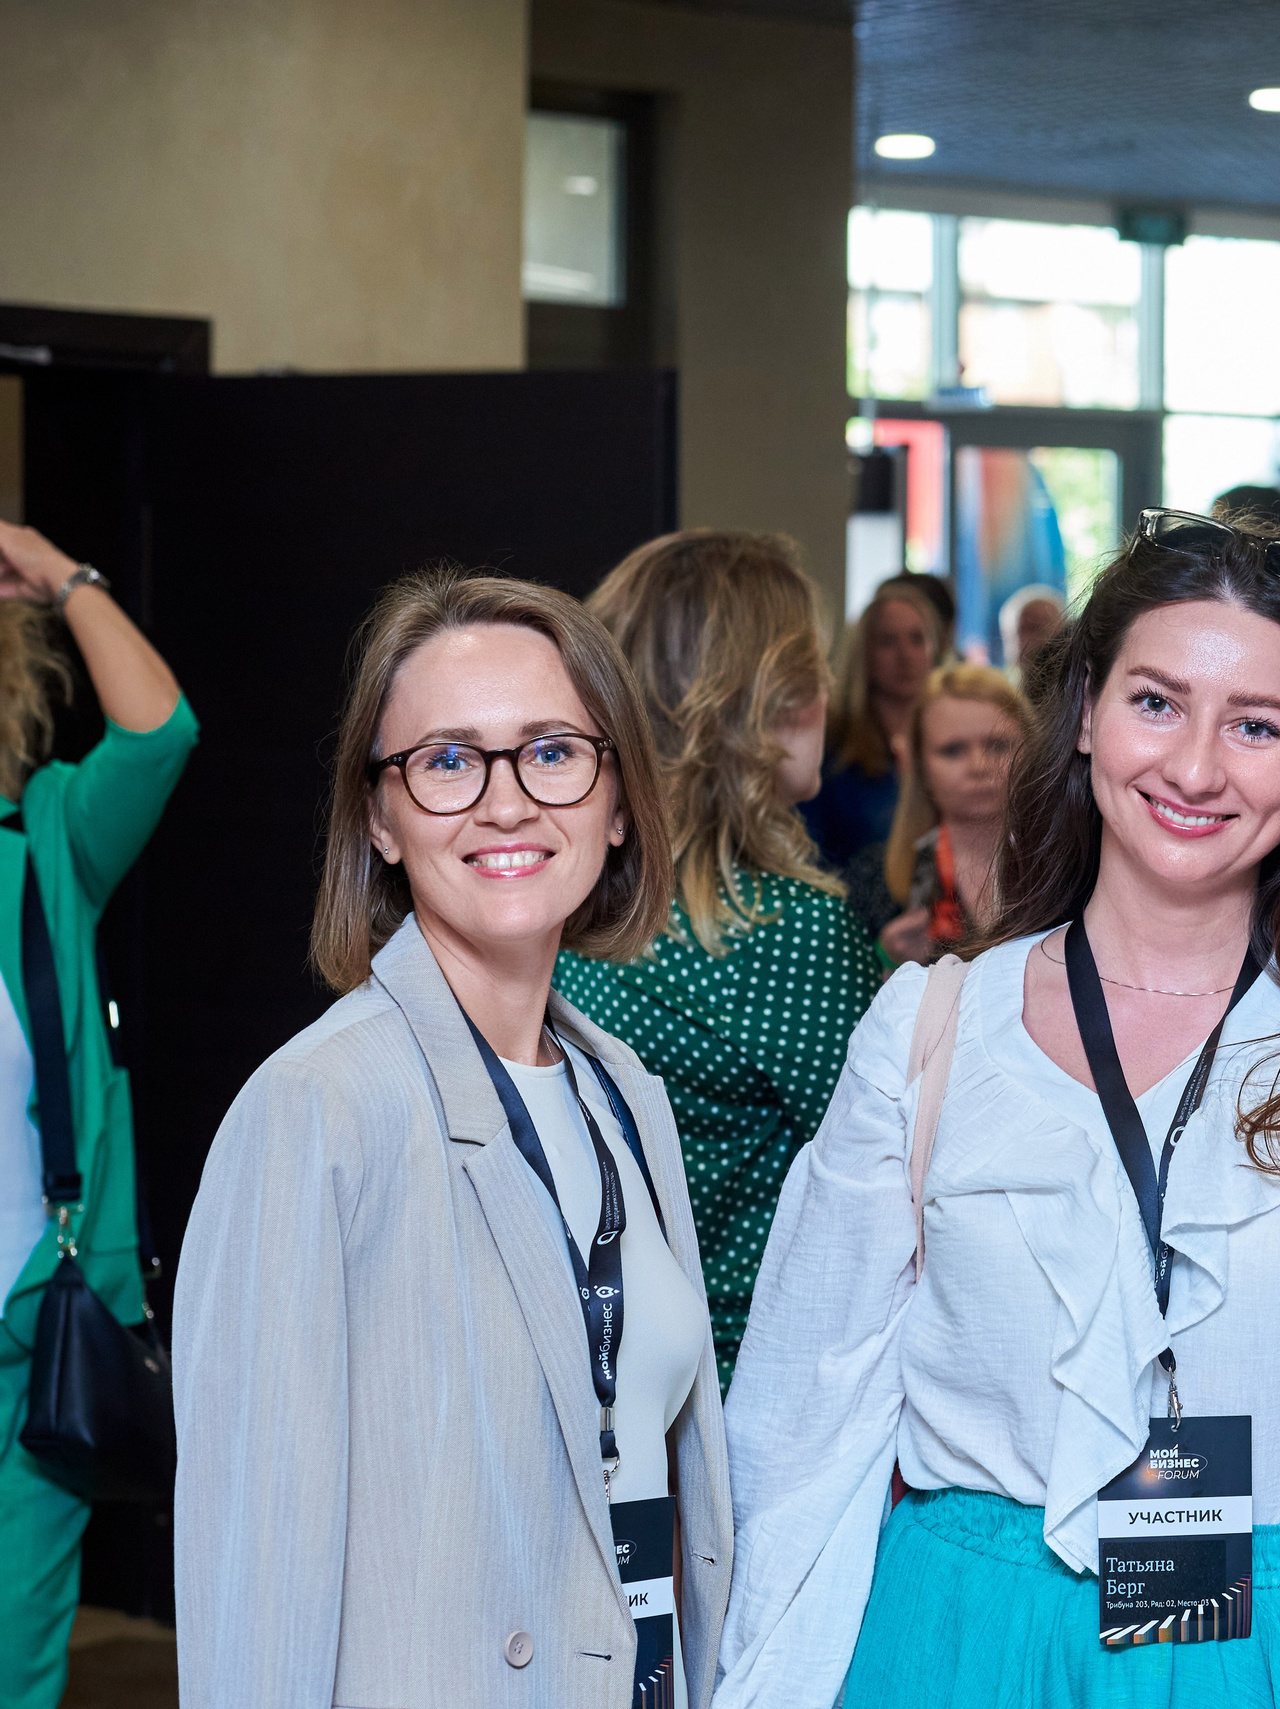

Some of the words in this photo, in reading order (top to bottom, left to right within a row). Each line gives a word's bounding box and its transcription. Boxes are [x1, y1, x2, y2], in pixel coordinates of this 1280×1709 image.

[598, 1303, 612, 1380] мойбизнес
[1149, 1443, 1179, 1458] МОЙ
[1150, 1458, 1199, 1469] БИЗНЕС
[1157, 1469, 1200, 1480] FORUM
[1128, 1508, 1223, 1525] УЧАСТНИК
[1106, 1557, 1175, 1573] Татьяна
[1106, 1579, 1145, 1598] Берг
[1106, 1600, 1134, 1610] Трибуна
[1150, 1600, 1165, 1608] Ряд:
[1165, 1600, 1177, 1608] 02,
[1177, 1599, 1200, 1607] Место:
